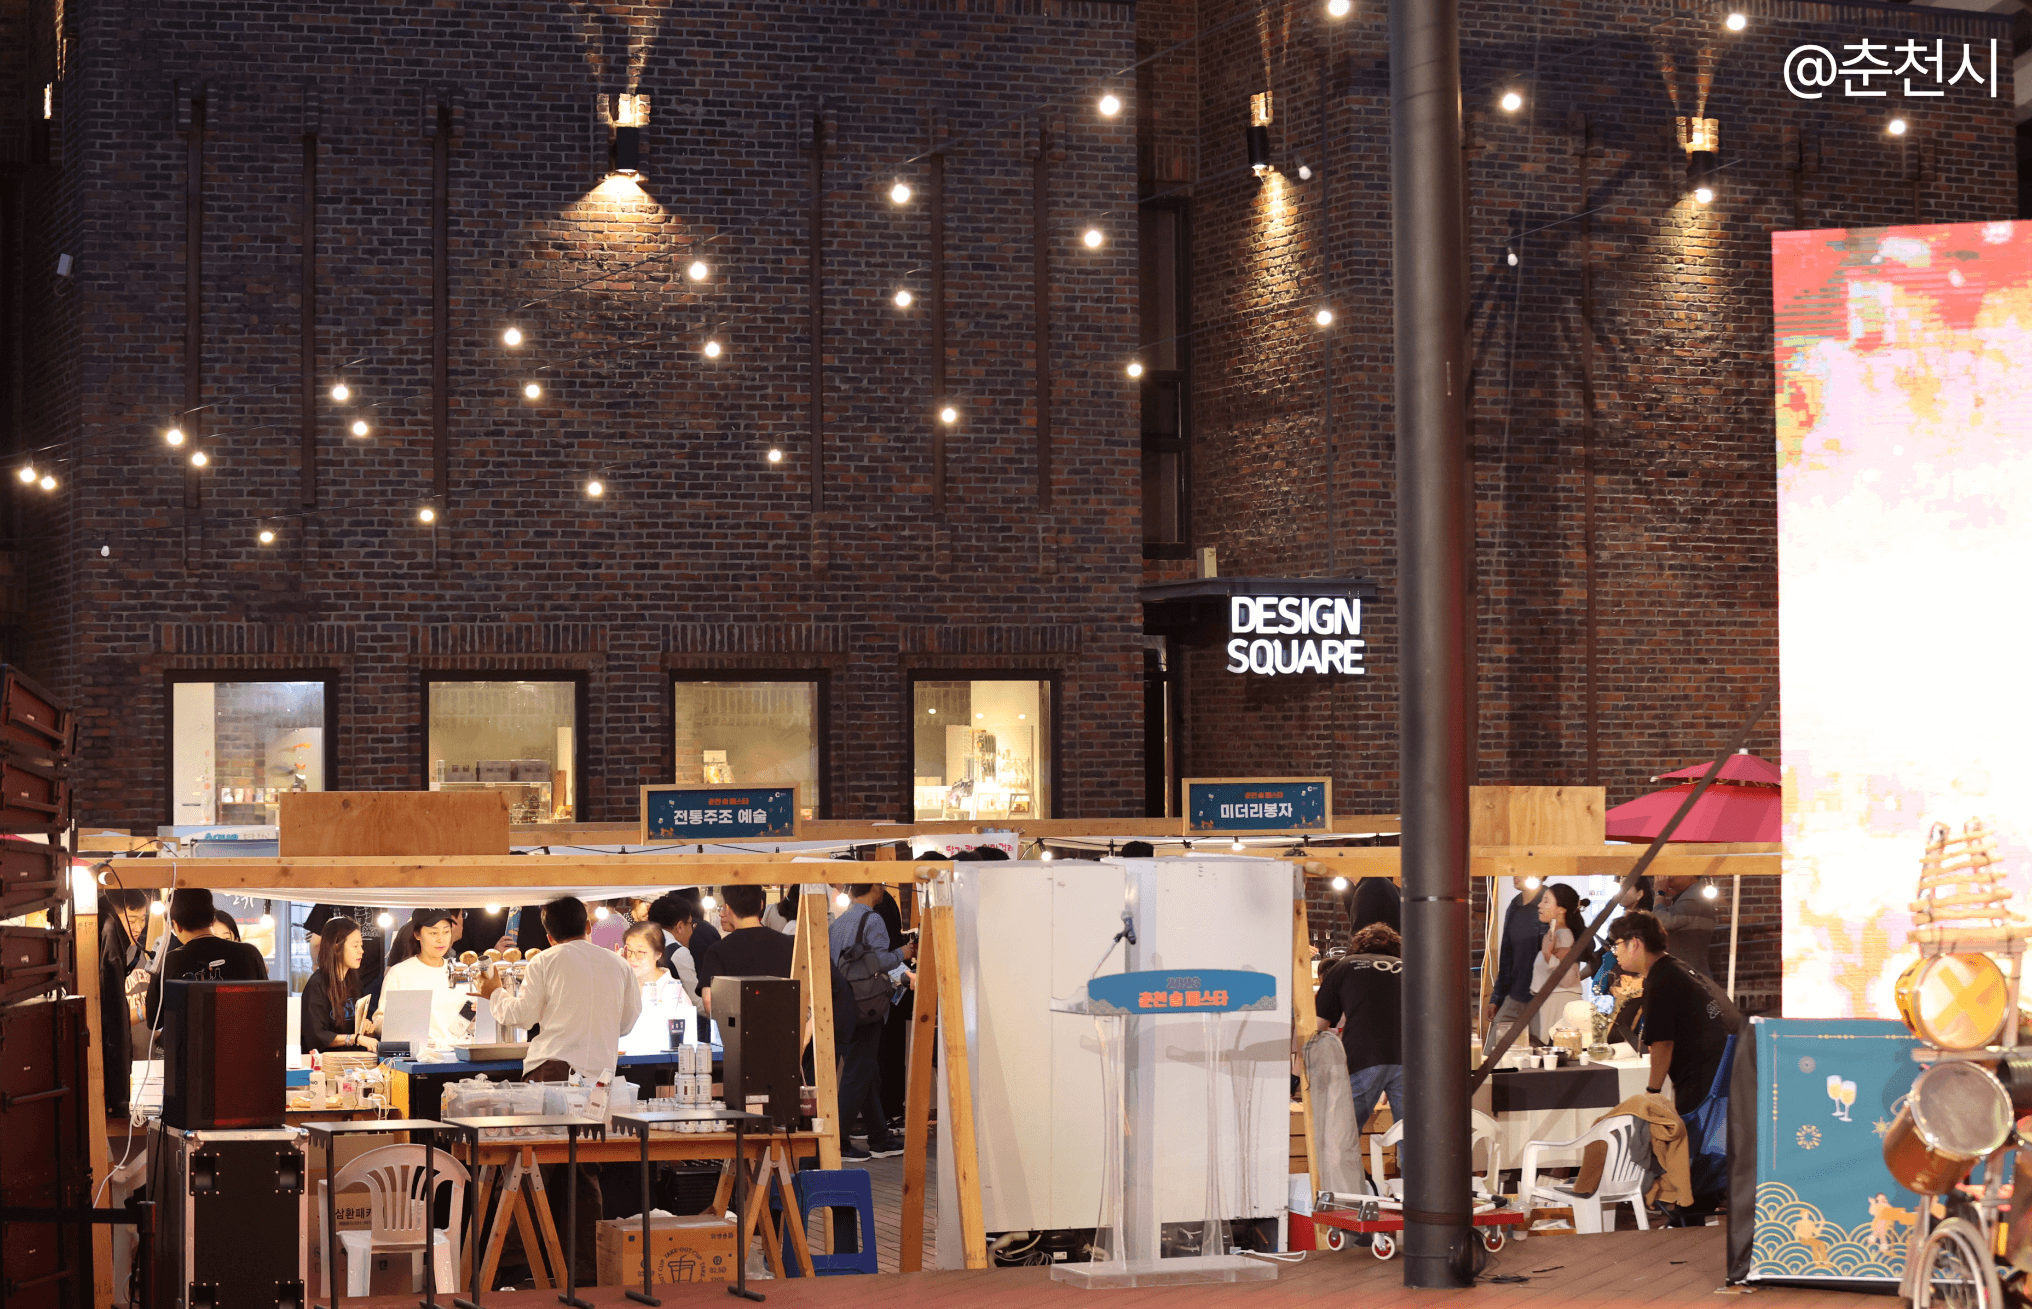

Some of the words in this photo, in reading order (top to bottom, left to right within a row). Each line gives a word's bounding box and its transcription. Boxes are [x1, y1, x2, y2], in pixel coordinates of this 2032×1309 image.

[1231, 596, 1361, 635] DESIGN
[1227, 638, 1365, 677] SQUARE
[673, 809, 733, 825] 전통주조
[737, 808, 767, 824] 예술
[1220, 803, 1293, 818] 미더리봉자
[1166, 975, 1202, 990] 2023
[1138, 991, 1168, 1008] 춘천
[1169, 991, 1184, 1007] 술
[1184, 990, 1229, 1007] 페스타
[335, 1207, 384, 1220] 삼환패키
